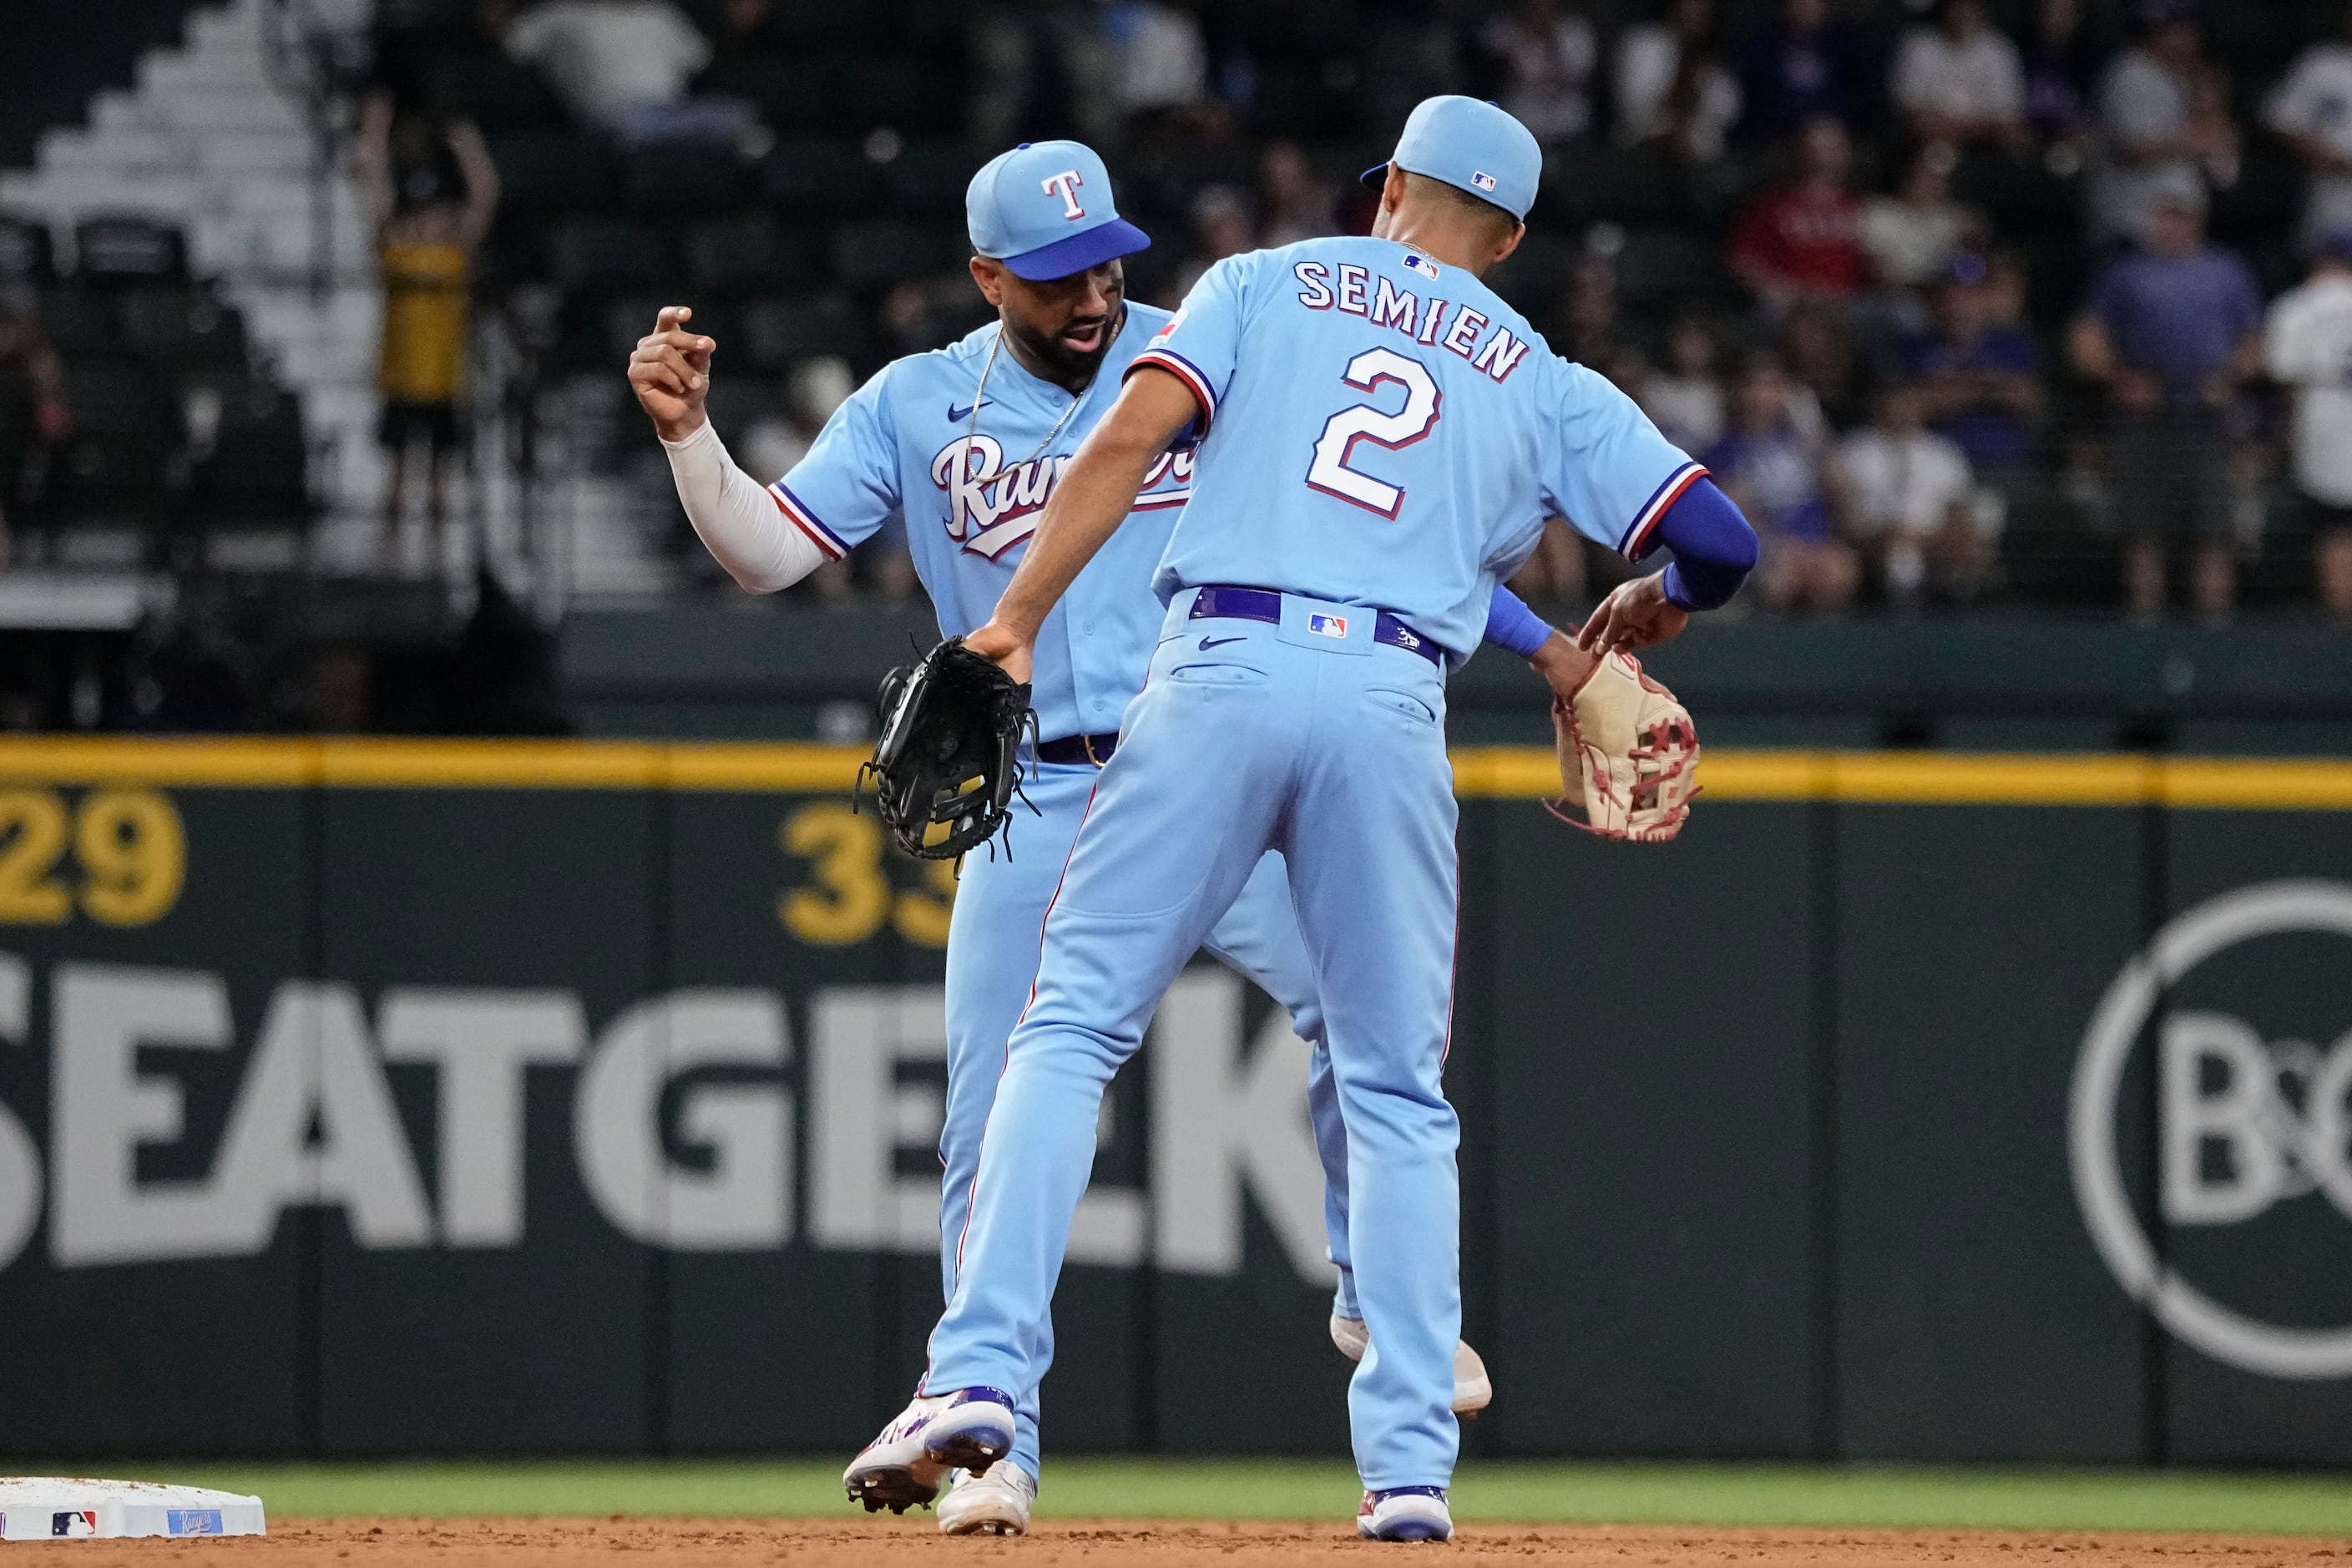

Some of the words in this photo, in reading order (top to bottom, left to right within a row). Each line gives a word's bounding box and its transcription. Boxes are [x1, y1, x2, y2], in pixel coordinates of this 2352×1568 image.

[1041, 169, 1085, 222] T
[1293, 261, 1530, 384] SEMIEN
[1304, 345, 1443, 522] 2
